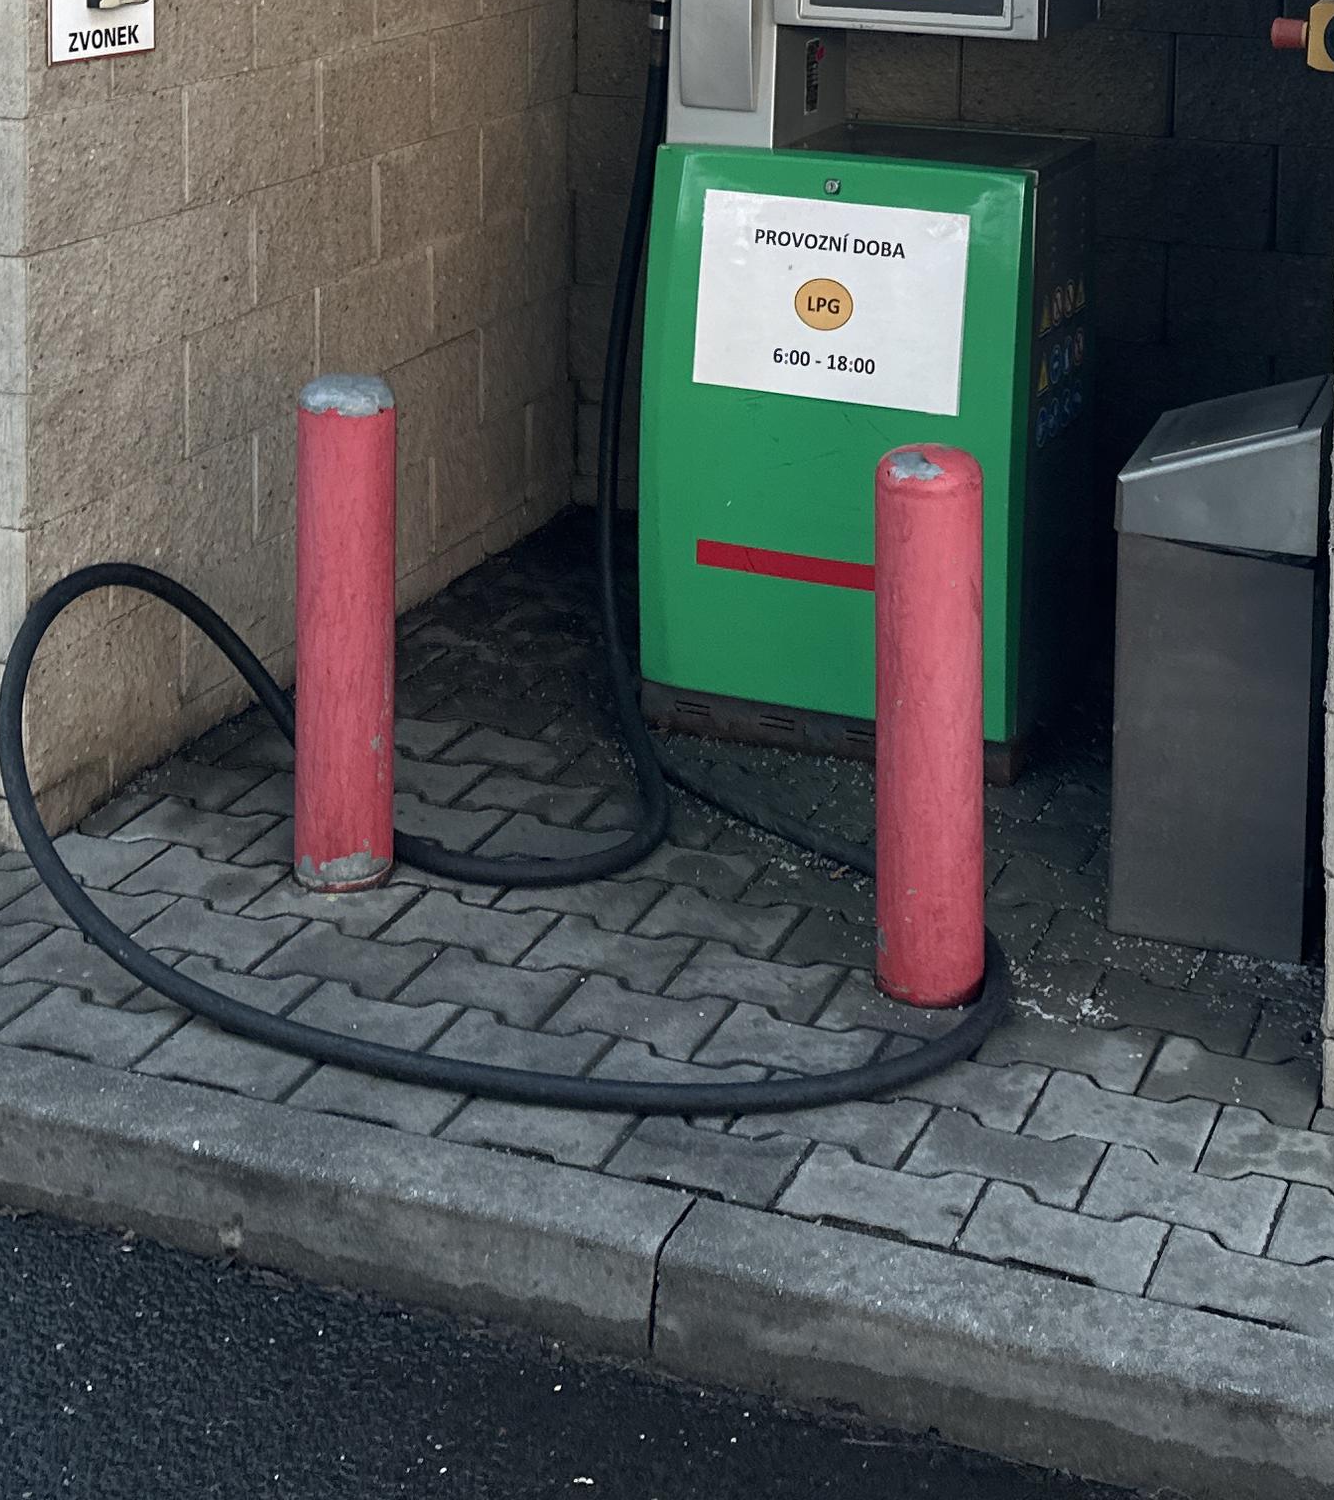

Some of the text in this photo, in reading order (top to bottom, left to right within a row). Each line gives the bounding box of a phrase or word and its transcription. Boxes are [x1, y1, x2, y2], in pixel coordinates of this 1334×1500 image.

[68, 24, 140, 53] ZVONEK
[754, 228, 906, 259] PROVOZNÍ DOBA
[807, 295, 841, 315] LPG
[773, 348, 811, 367] 6:00
[827, 354, 876, 375] 18:00
